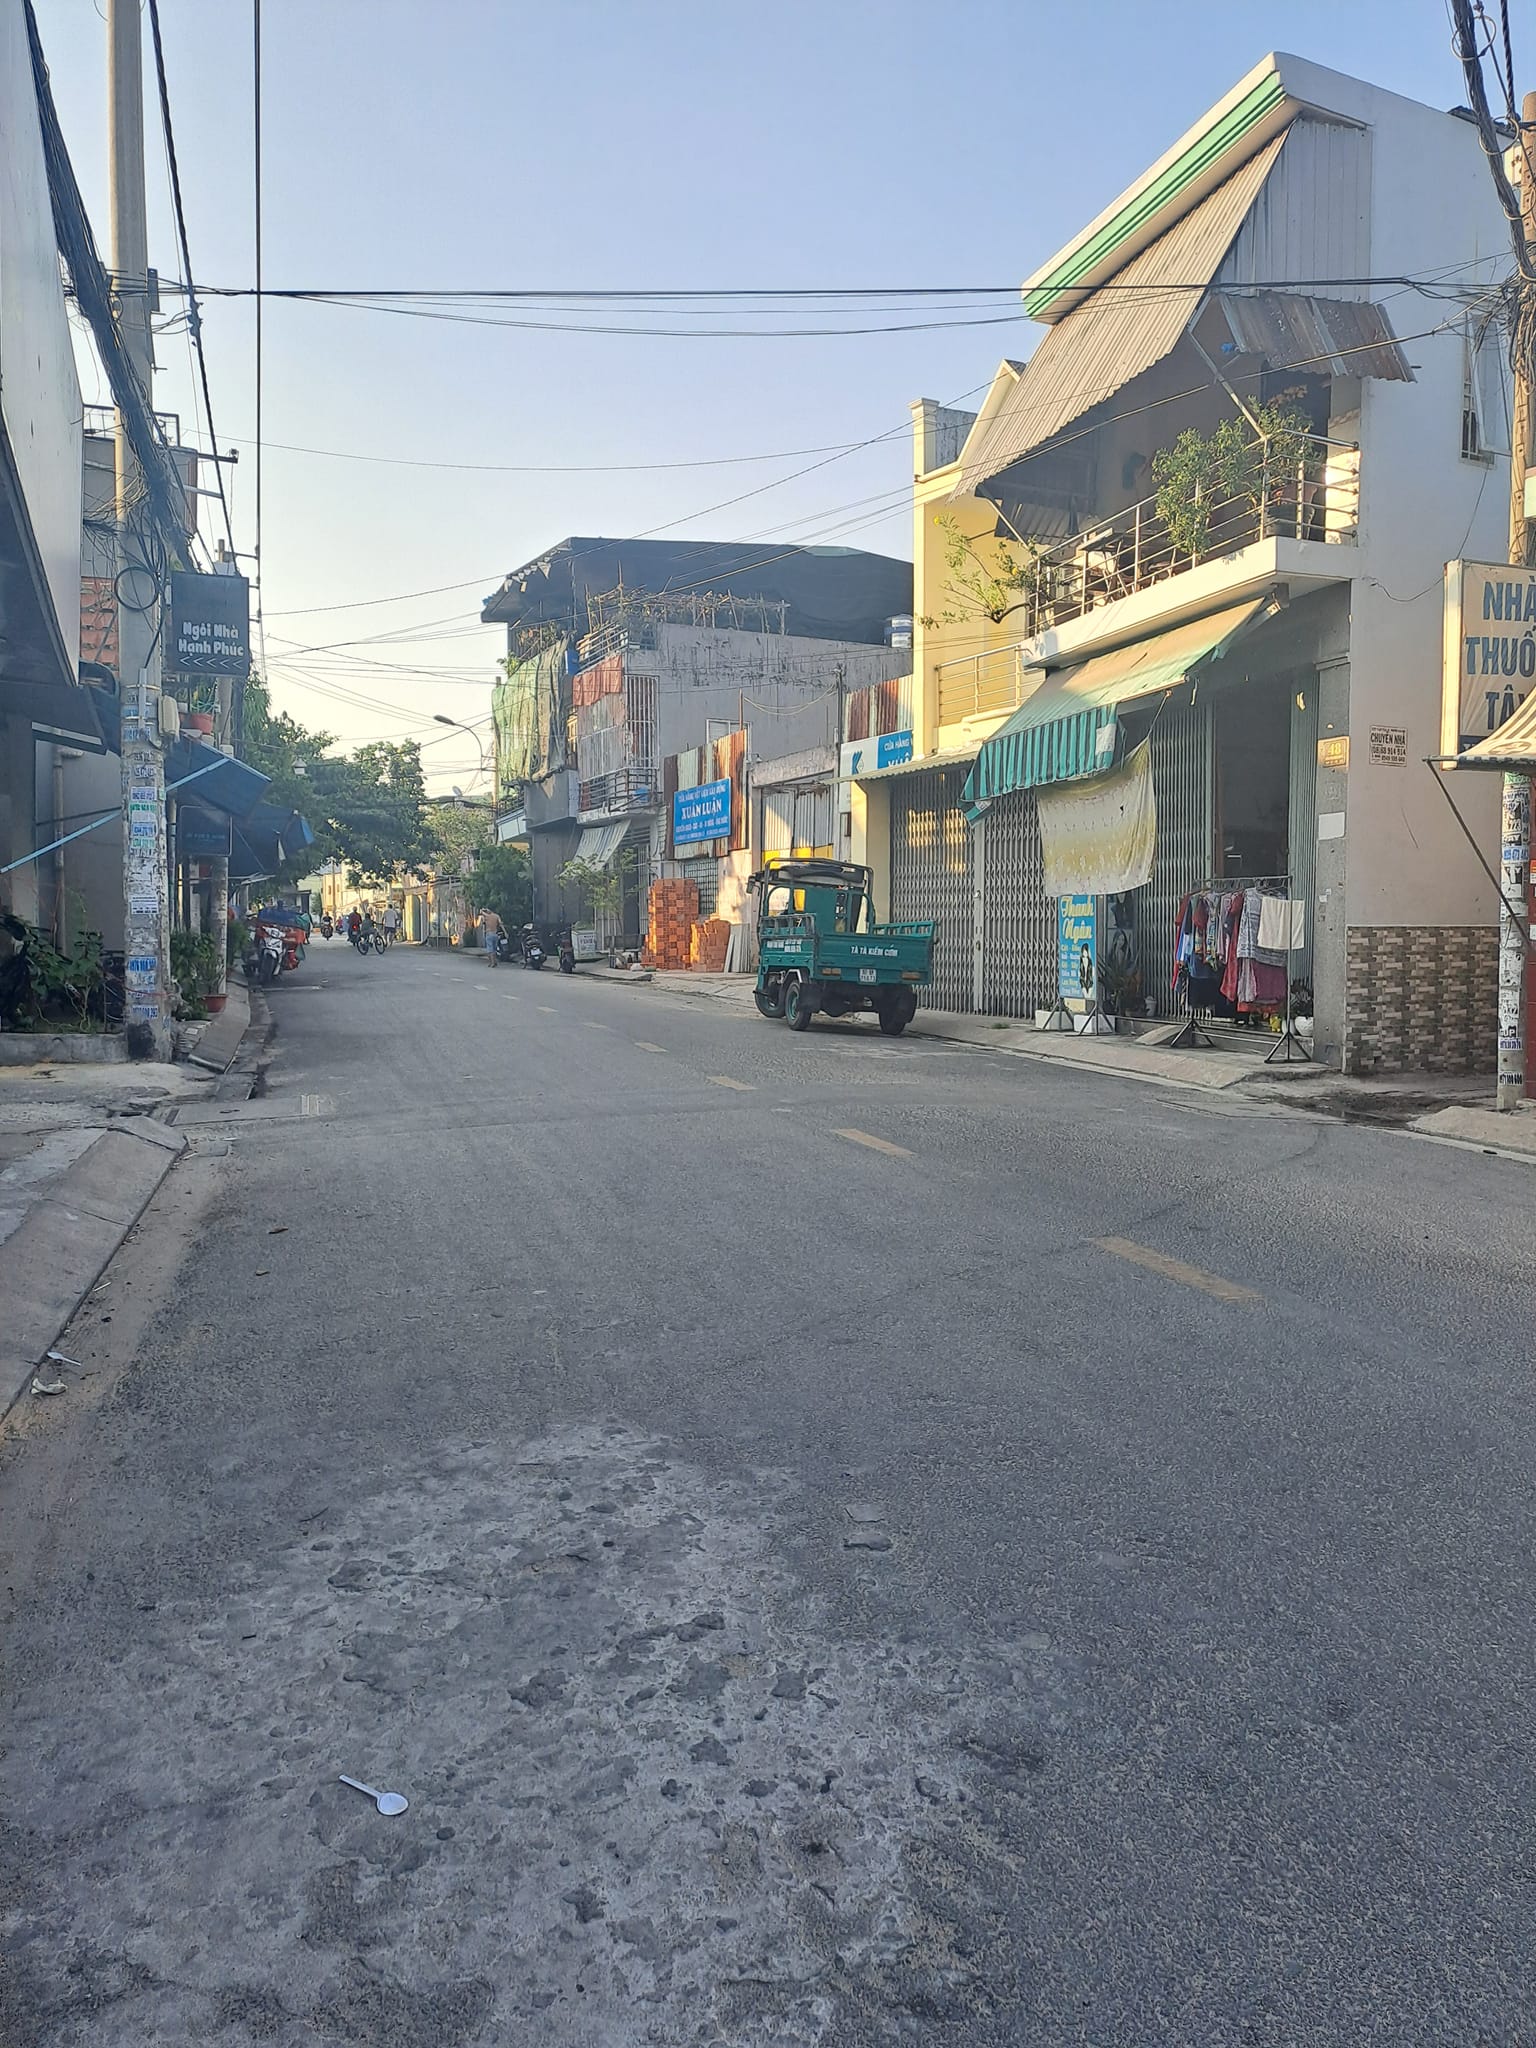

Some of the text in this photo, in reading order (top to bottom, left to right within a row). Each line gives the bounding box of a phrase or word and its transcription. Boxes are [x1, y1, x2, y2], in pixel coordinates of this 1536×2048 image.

[183, 621, 239, 640] Ngôi Nhà
[178, 639, 245, 657] Hạnh Phúc
[1327, 742, 1342, 756] 48
